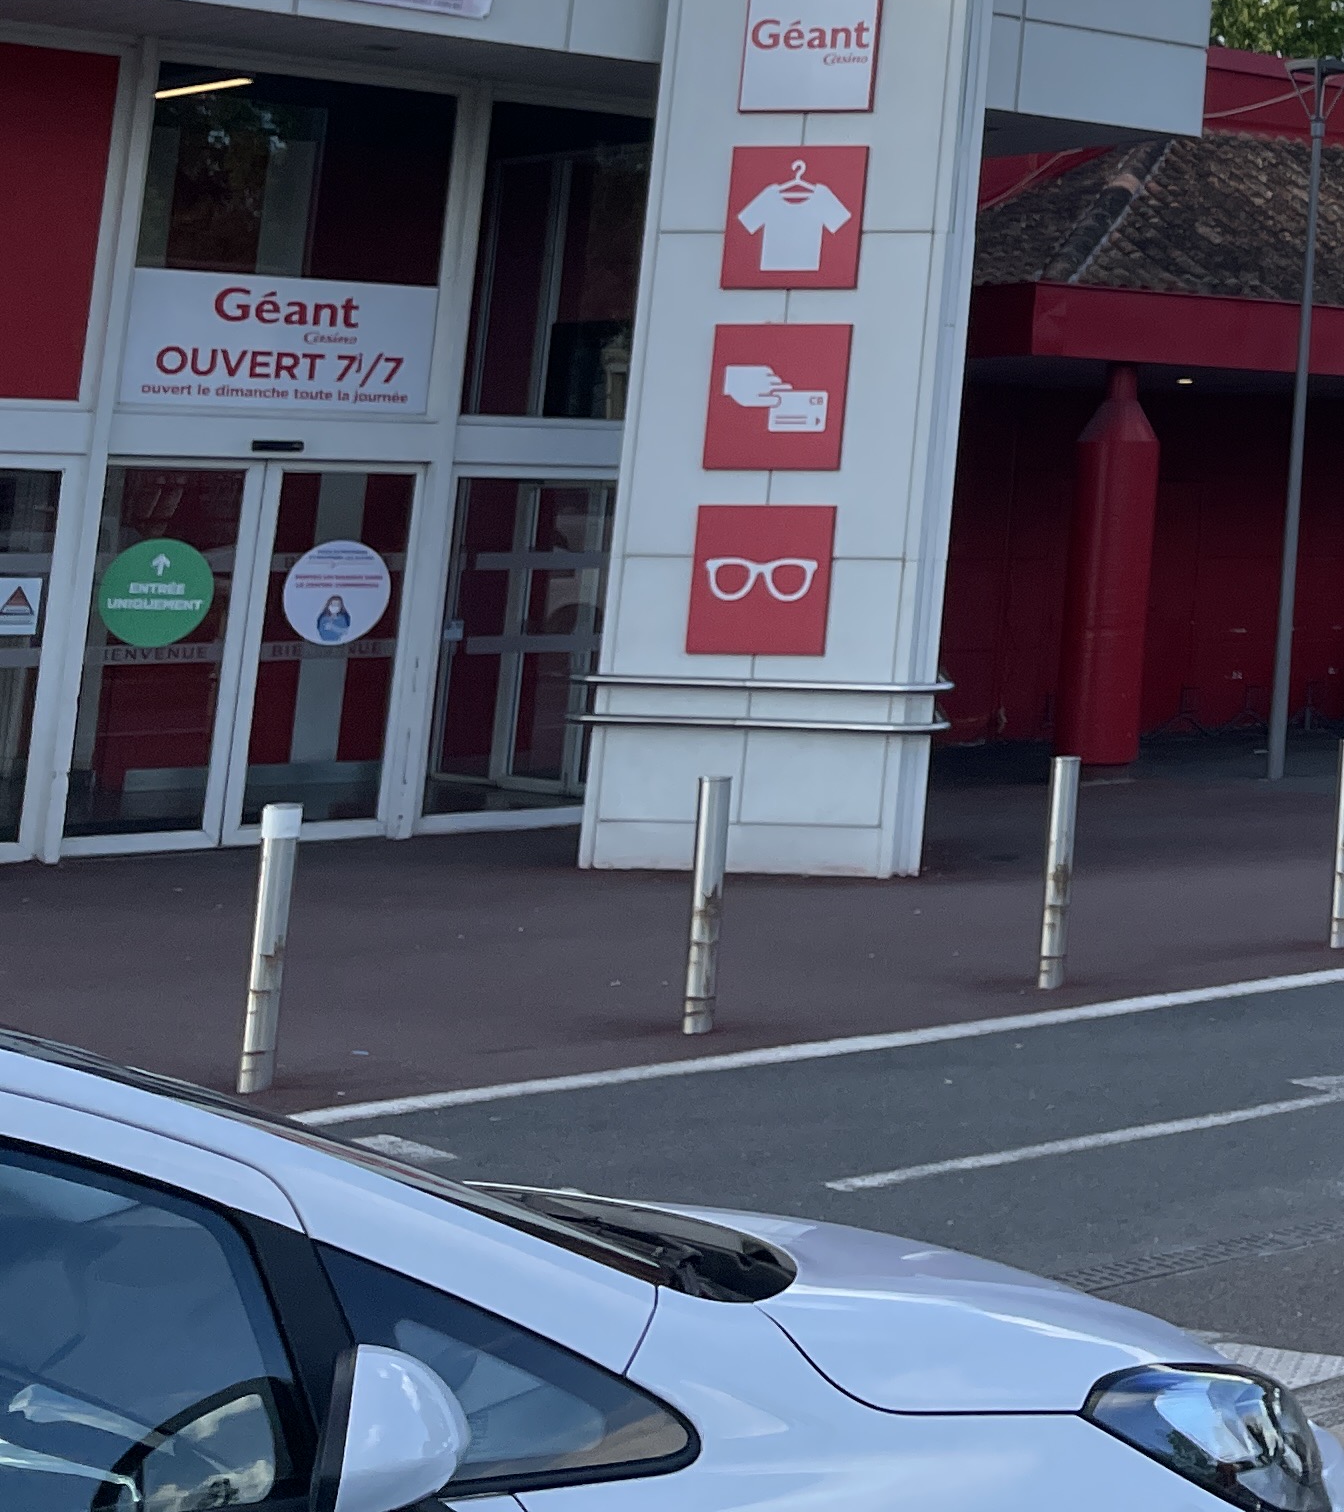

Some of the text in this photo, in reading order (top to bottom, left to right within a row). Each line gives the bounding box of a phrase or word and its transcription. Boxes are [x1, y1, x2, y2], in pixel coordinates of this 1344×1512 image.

[751, 18, 870, 50] Géant
[823, 53, 869, 66] Casino
[214, 287, 360, 329] Géant
[156, 345, 326, 382] OUVERT
[141, 384, 409, 405] ouvert le dimanche toute la journée
[106, 597, 203, 611] UNIQUEMENT
